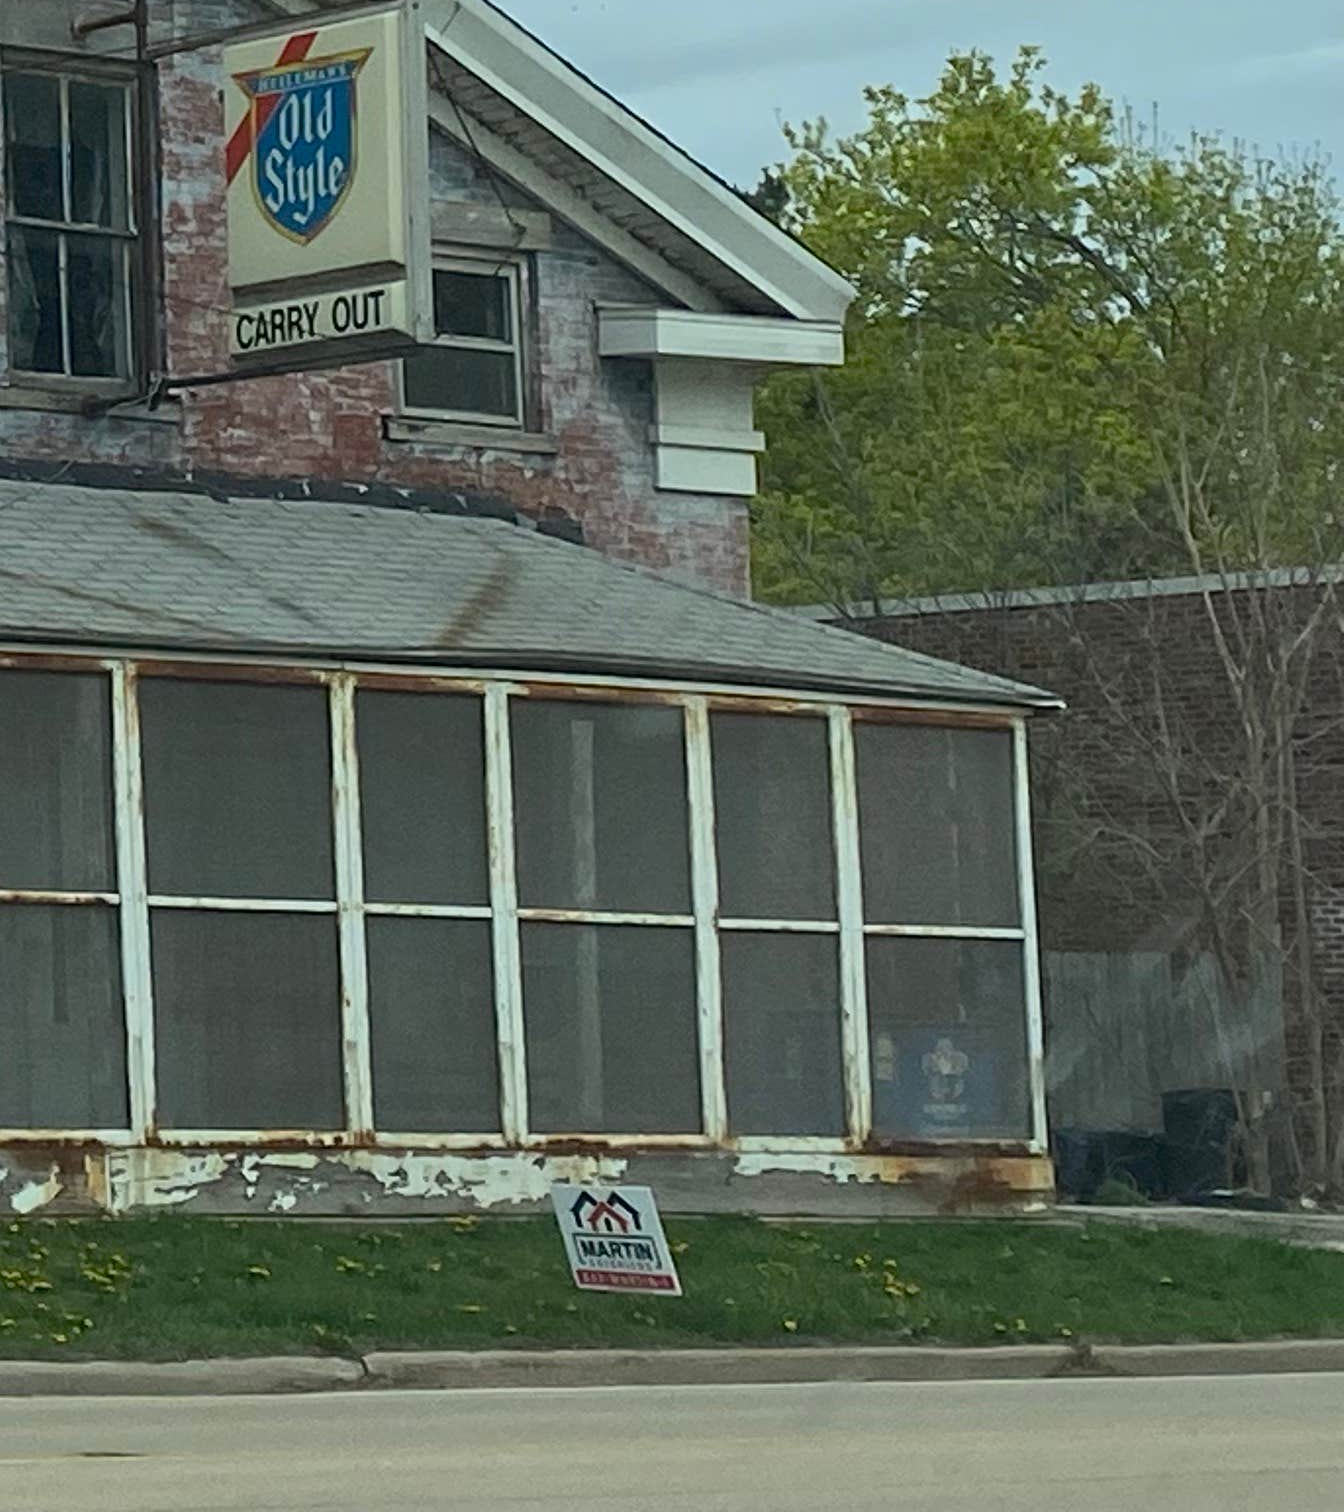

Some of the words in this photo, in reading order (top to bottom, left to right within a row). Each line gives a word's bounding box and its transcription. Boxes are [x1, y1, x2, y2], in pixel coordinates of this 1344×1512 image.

[279, 88, 332, 150] Old
[265, 145, 344, 224] Style
[236, 301, 319, 350] CARRY
[332, 289, 385, 332] OUT
[579, 1240, 654, 1262] MARTIN
